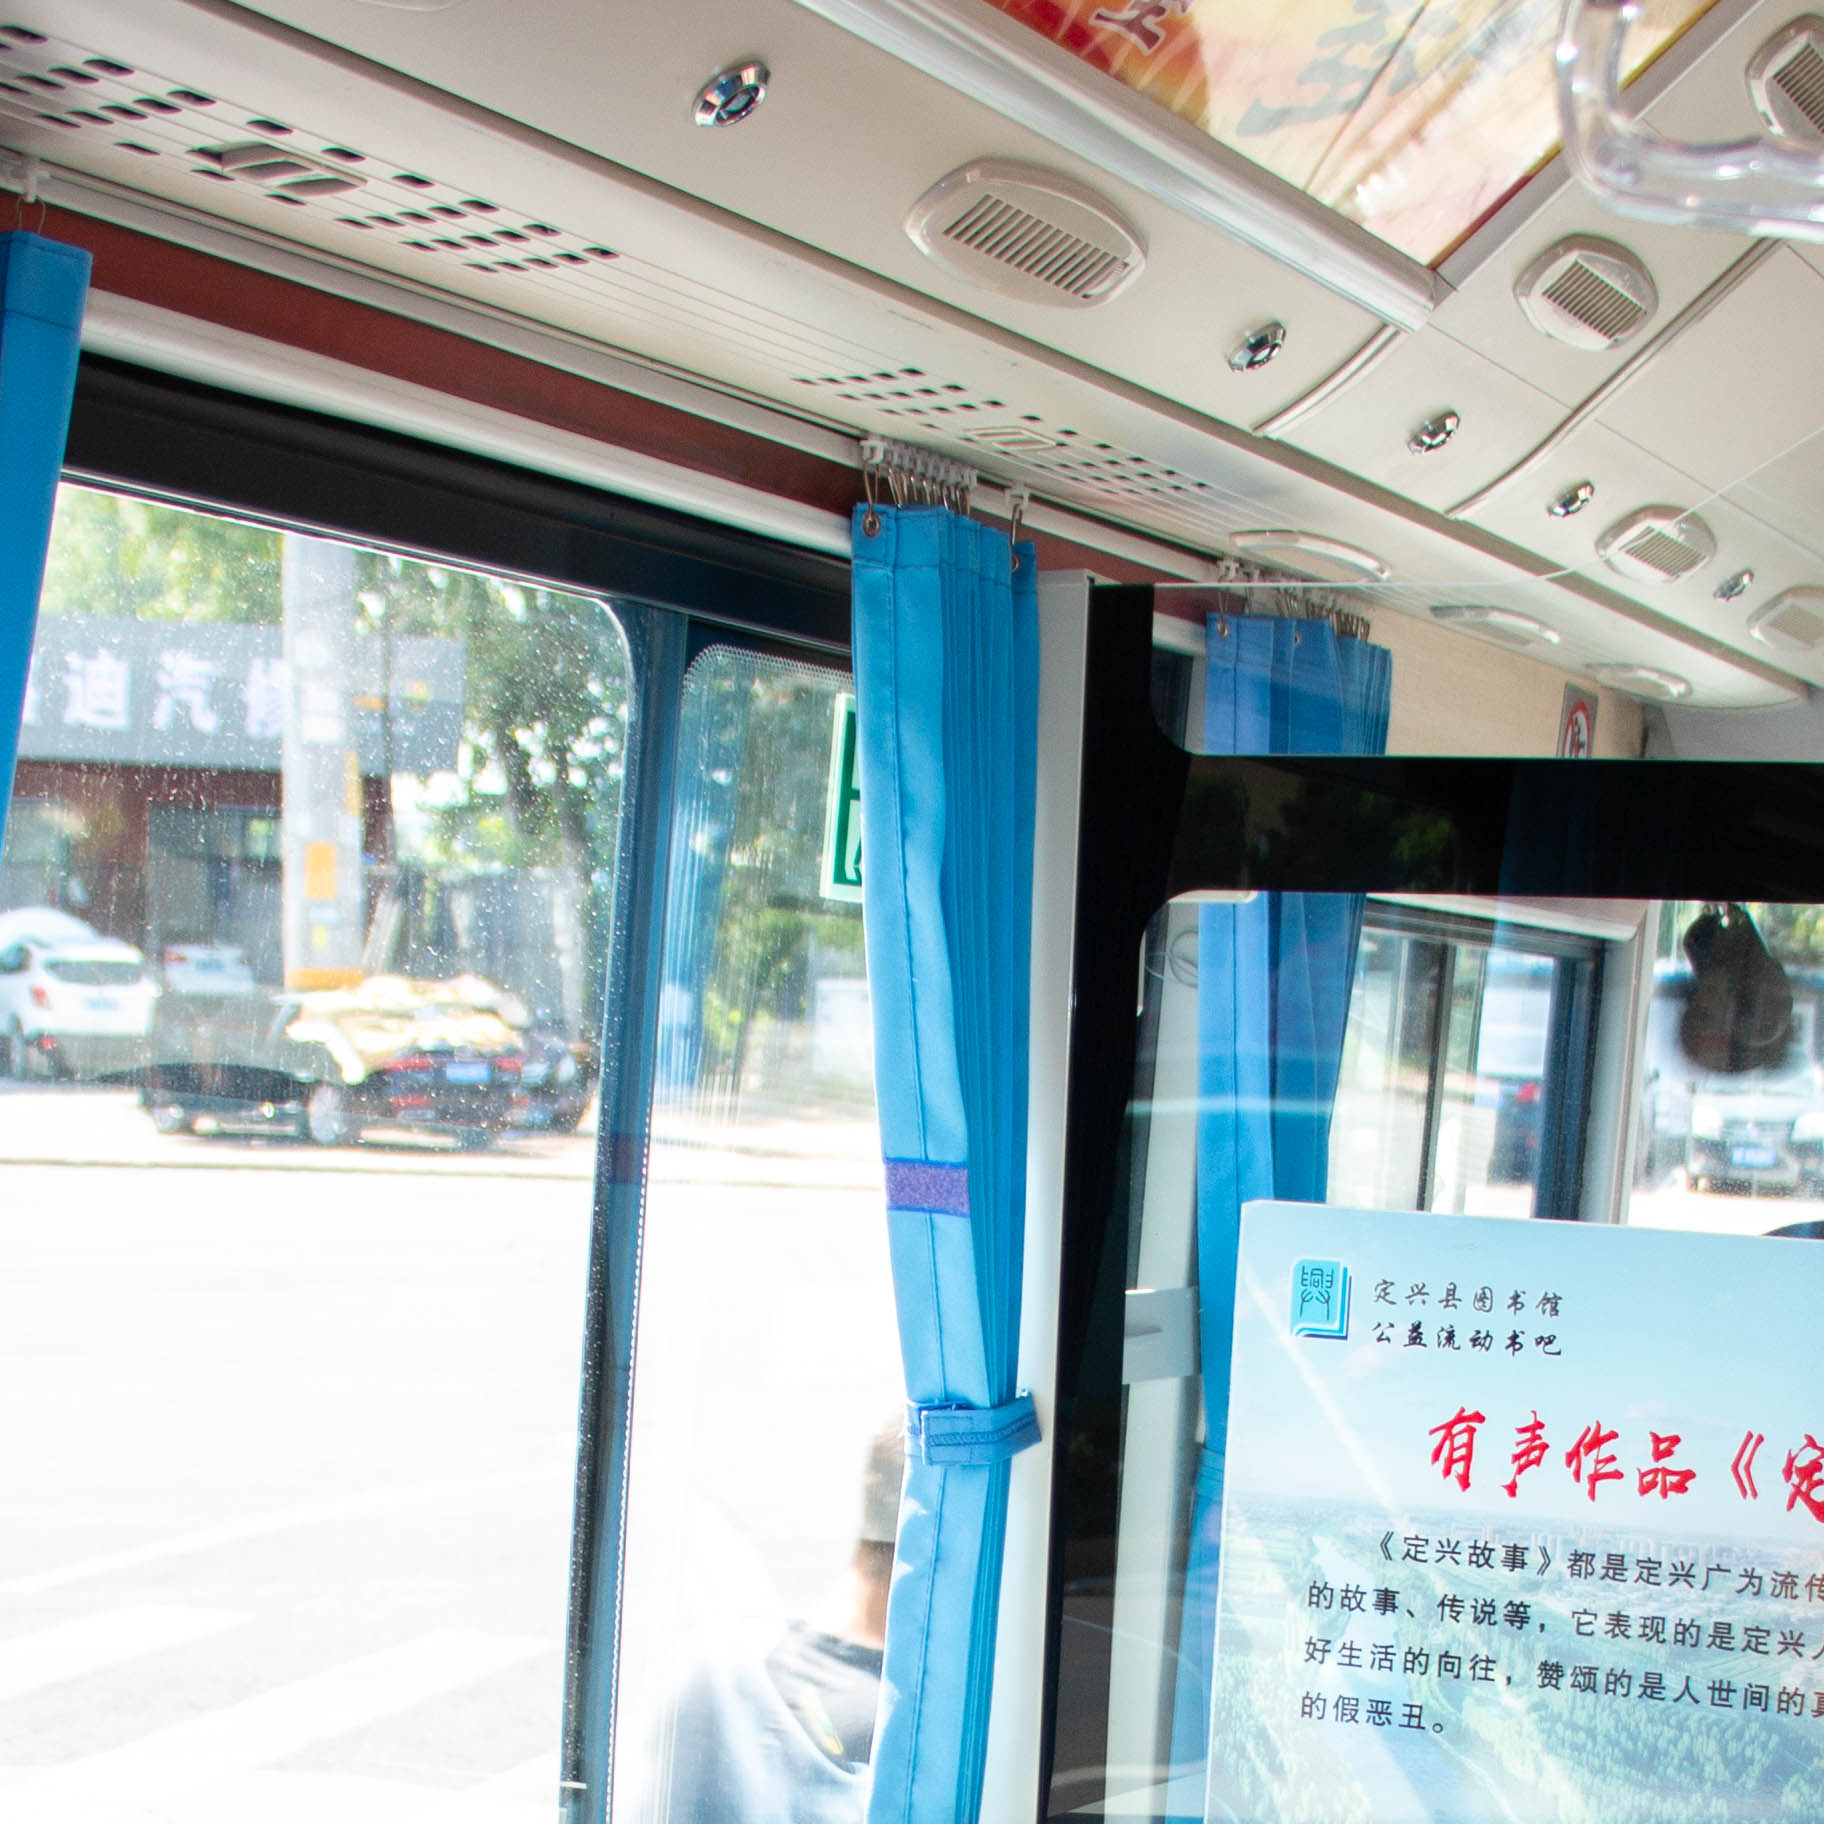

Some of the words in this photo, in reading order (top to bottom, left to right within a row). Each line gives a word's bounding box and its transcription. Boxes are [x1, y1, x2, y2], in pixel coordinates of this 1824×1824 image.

[1372, 1278, 1564, 1318] 定兴县图书馆
[1370, 1320, 1563, 1357] 公益流动书吧
[1299, 1691, 1446, 1735] 的假恶丑。
